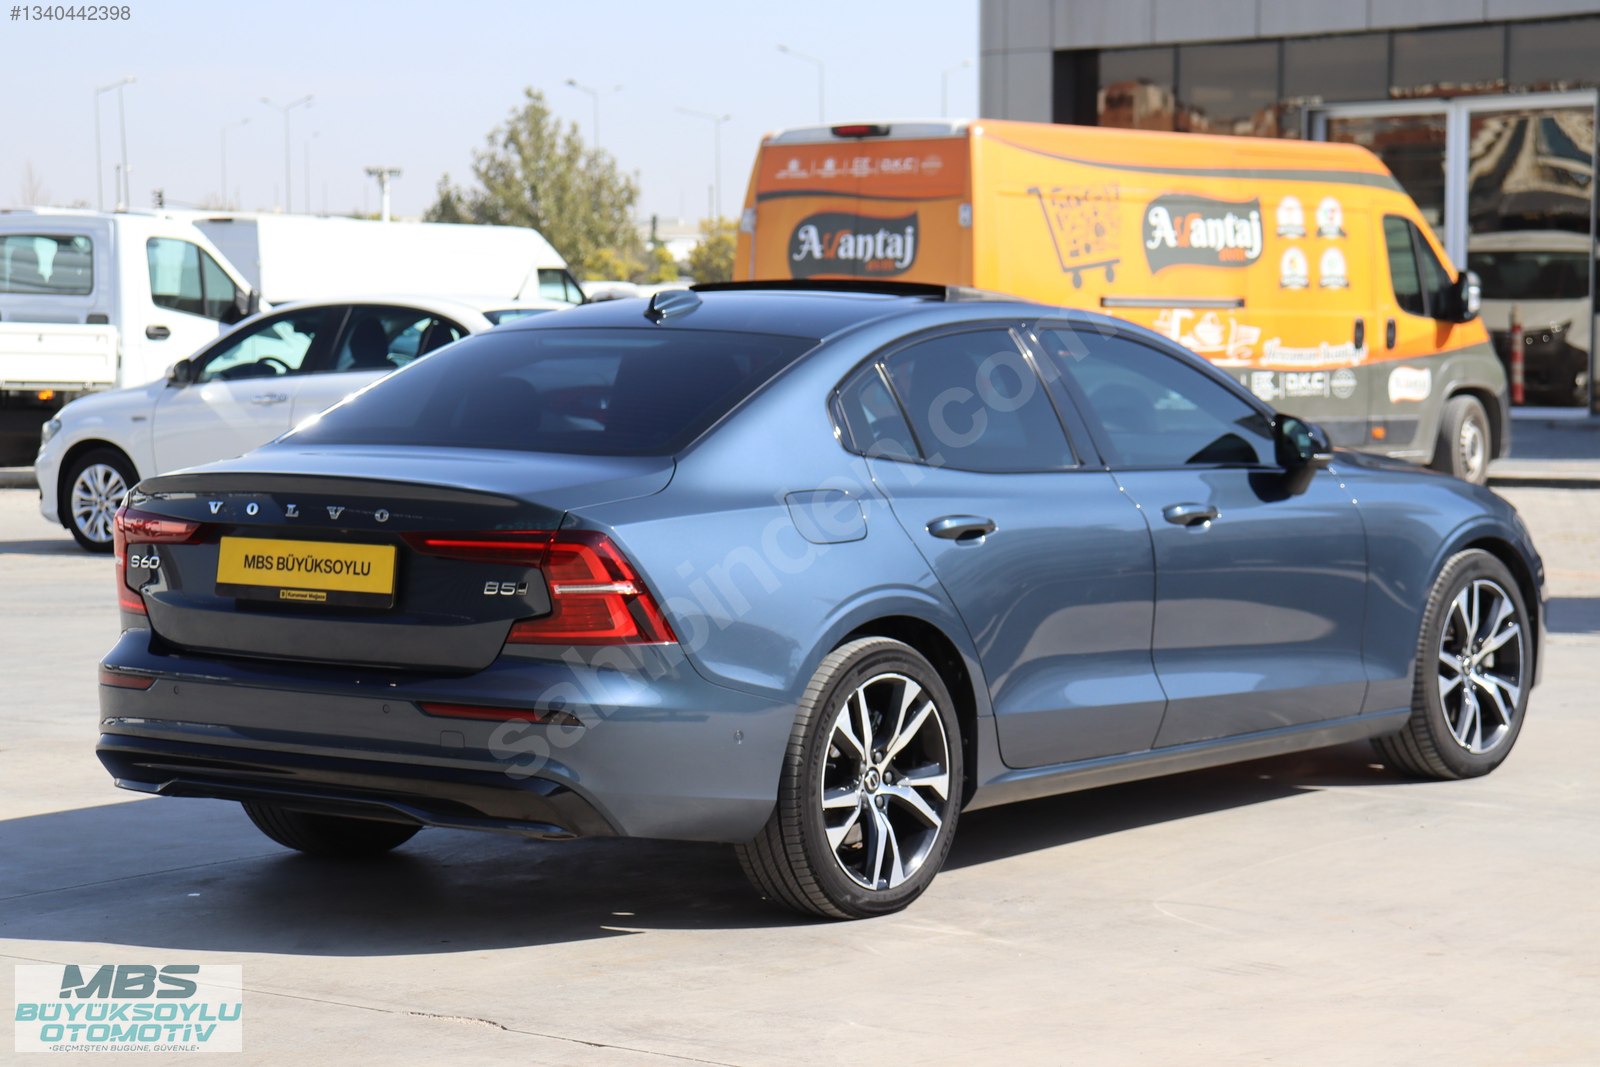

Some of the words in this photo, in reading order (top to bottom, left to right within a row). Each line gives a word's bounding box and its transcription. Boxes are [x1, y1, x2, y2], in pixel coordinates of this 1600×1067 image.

[1146, 206, 1262, 259] Avantaj
[792, 224, 915, 269] Avantaj
[208, 501, 390, 523] VOLVO
[131, 554, 160, 569] S60
[243, 554, 274, 570] MBS
[276, 554, 371, 577] BÜYÜKSOYLU
